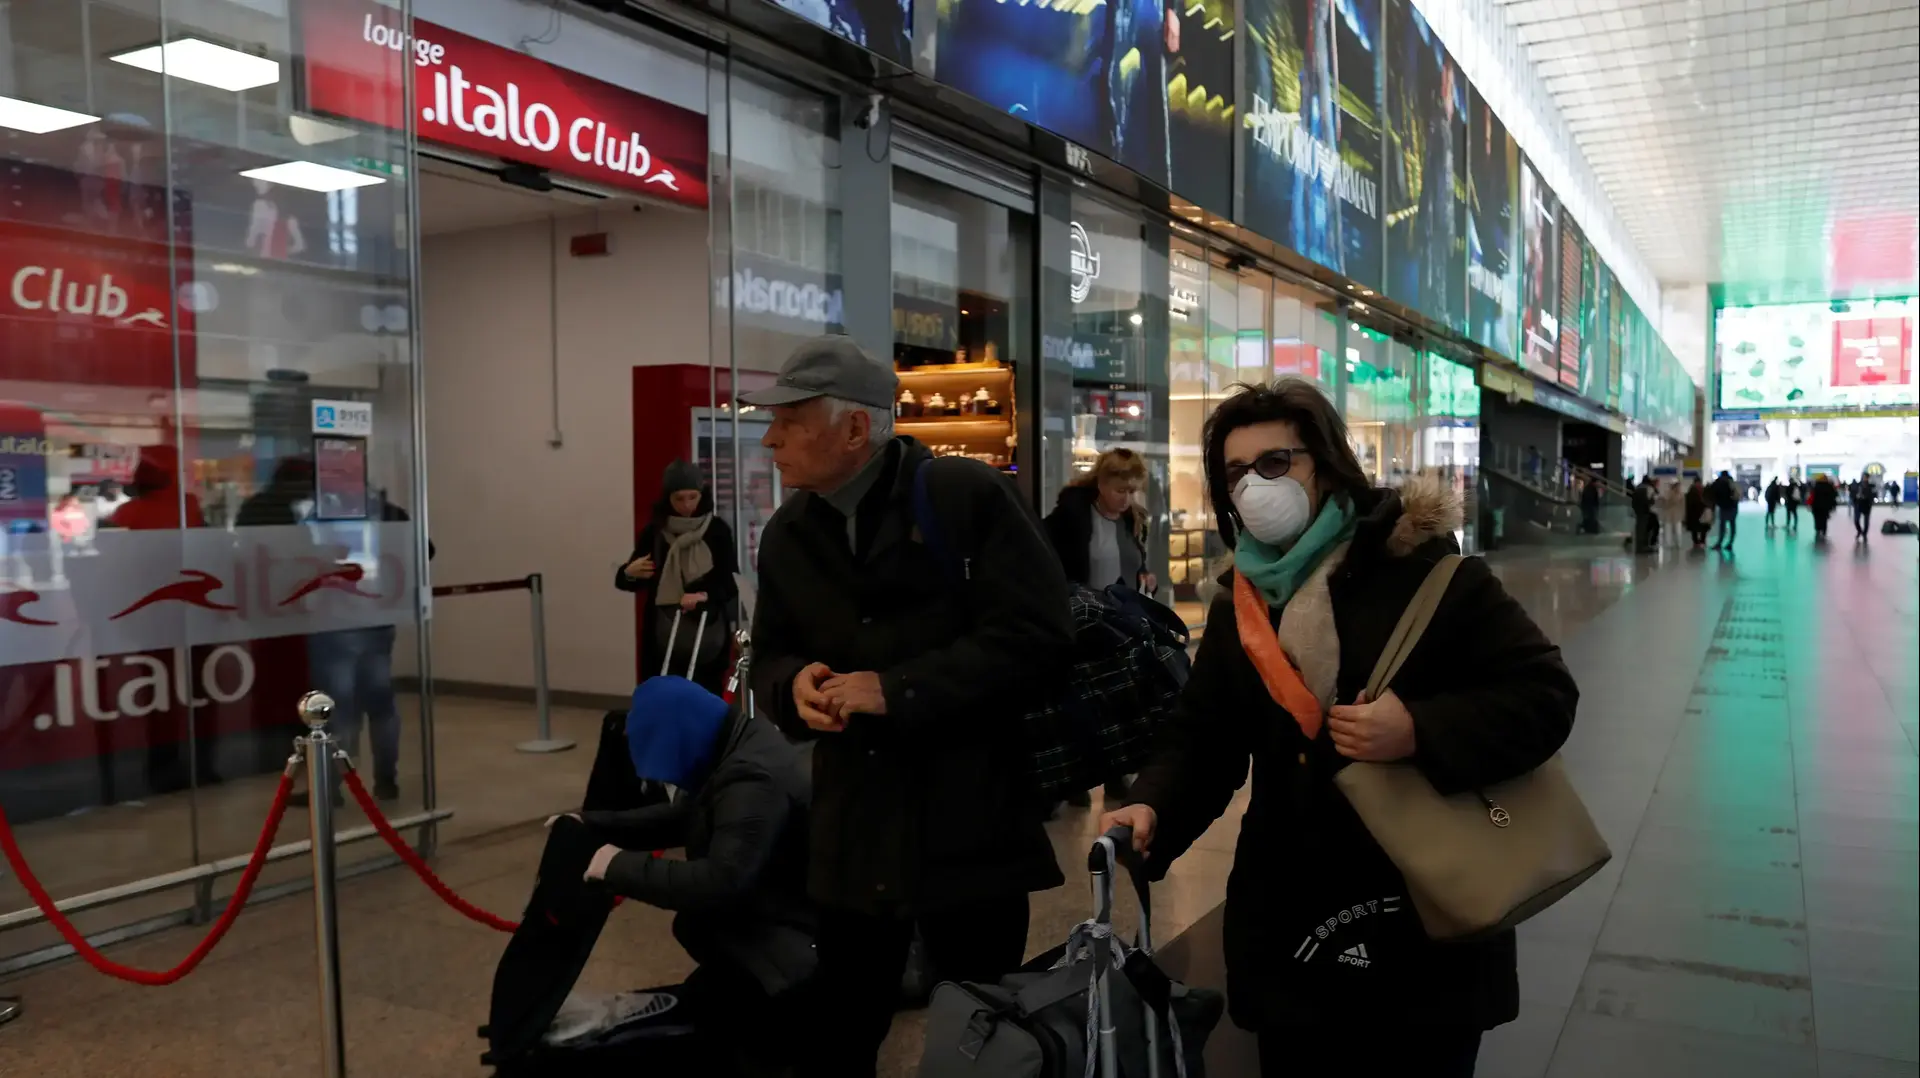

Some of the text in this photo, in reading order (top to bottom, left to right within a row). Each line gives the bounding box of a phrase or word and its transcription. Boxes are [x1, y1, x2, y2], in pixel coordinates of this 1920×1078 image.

[363, 13, 446, 67] louge
[568, 117, 651, 177] Club
[11, 265, 129, 318] Club
[1315, 900, 1378, 939] SPORT
[1337, 954, 1371, 968] SPORT
